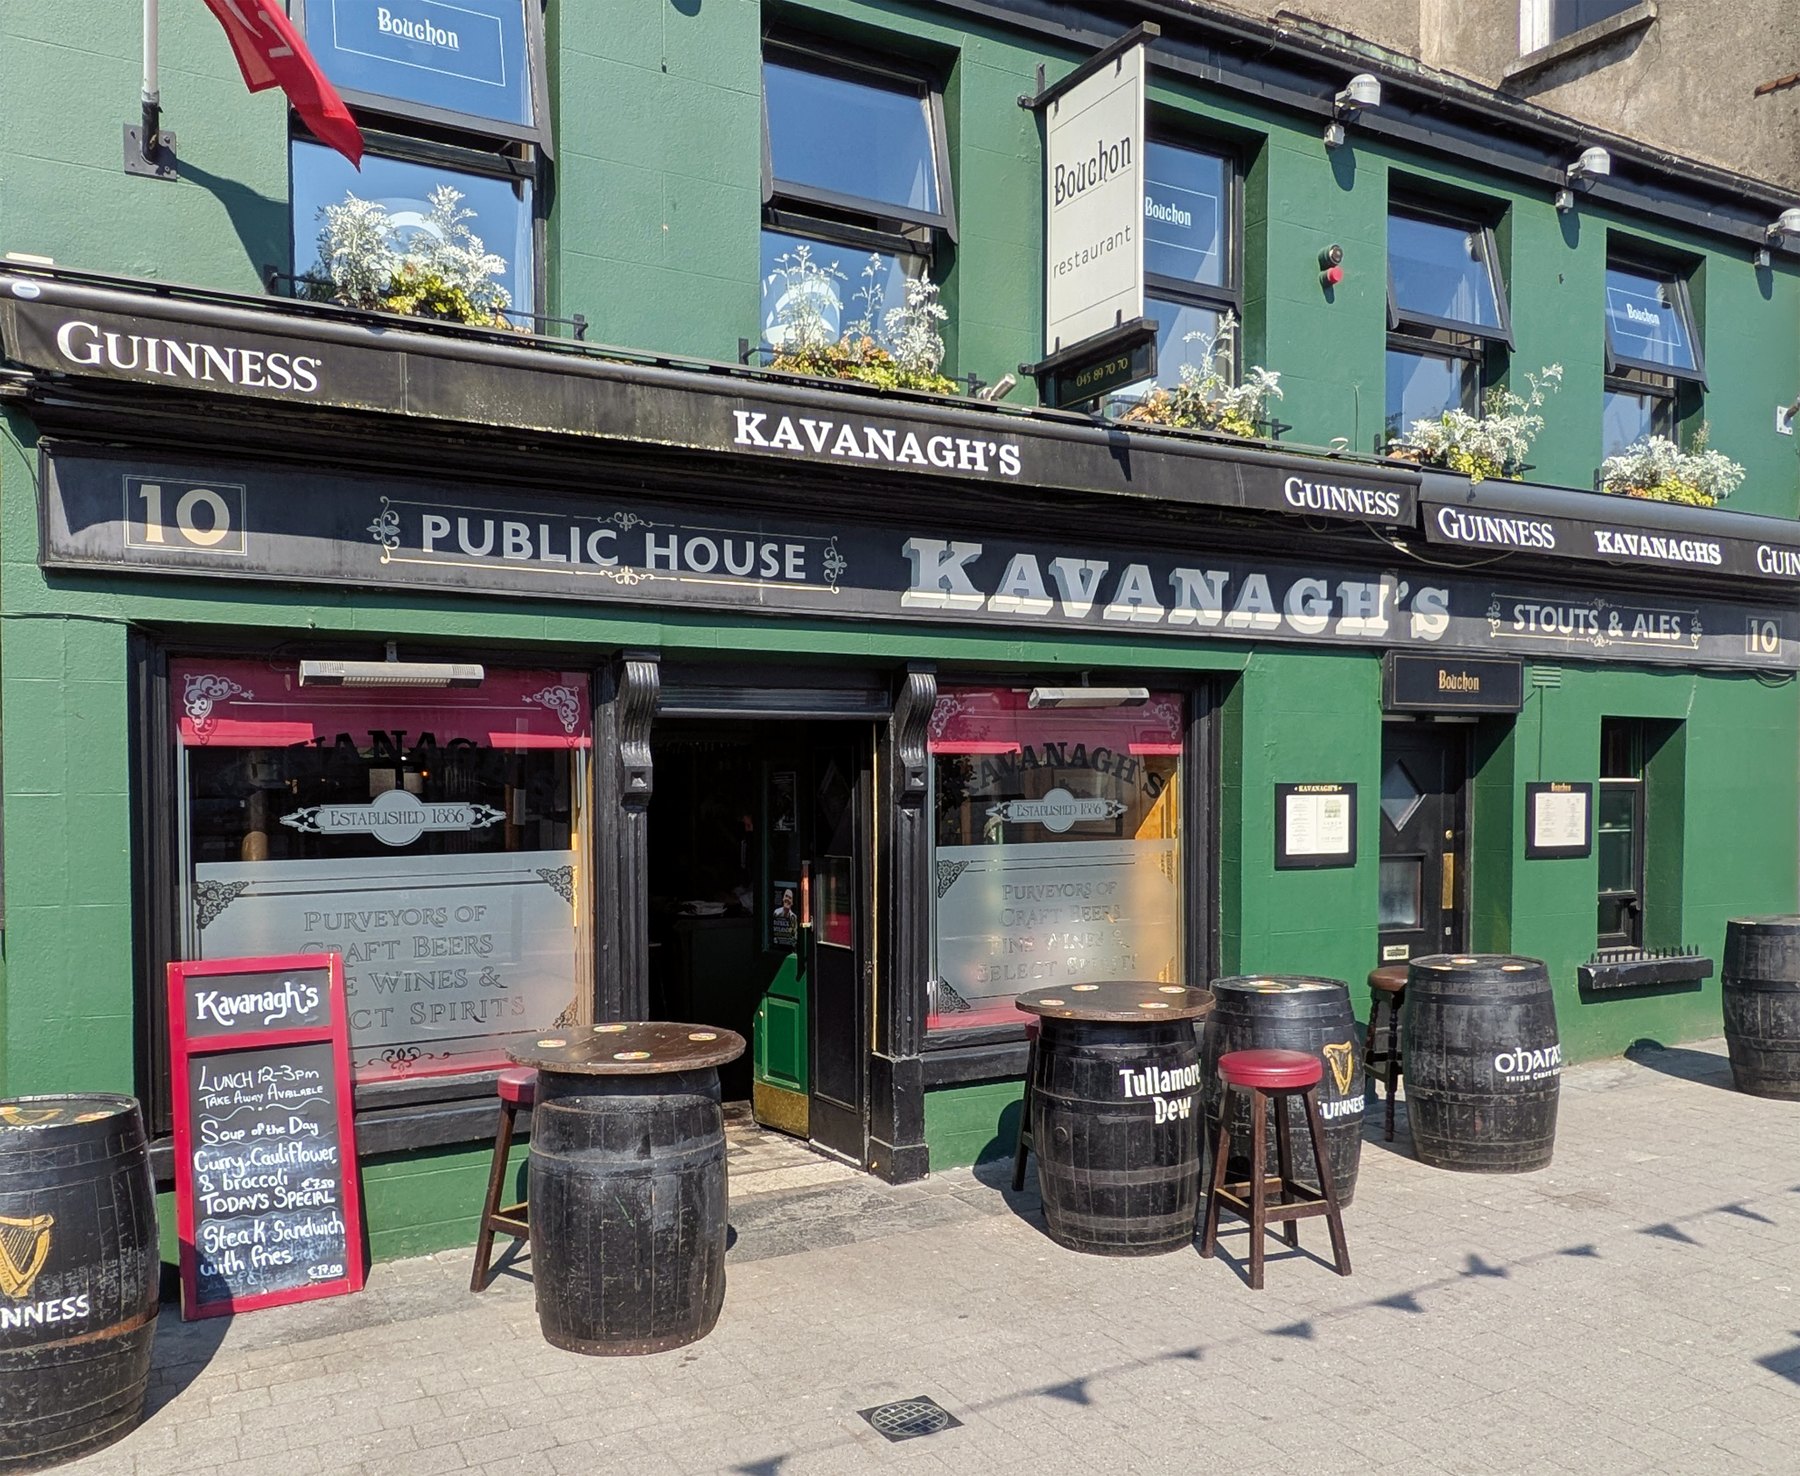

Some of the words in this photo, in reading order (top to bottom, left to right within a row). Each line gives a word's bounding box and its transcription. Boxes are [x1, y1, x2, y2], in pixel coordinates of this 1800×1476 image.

[377, 7, 460, 49] Bouchon
[1053, 136, 1132, 206] Bouchon
[1145, 196, 1191, 226] Bouchon
[1053, 225, 1132, 279] restaurant
[1626, 303, 1660, 326] Bouchon
[56, 321, 322, 392] GUINNESS
[1076, 373, 1091, 387] 045
[1093, 367, 1103, 381] 89
[1105, 362, 1115, 374] 70
[1117, 357, 1128, 370] 70
[733, 410, 1021, 476] KAVANAGH'S
[1285, 477, 1400, 517] GUINNESS
[139, 484, 230, 546] 10
[1438, 507, 1555, 549] GUINNESS
[421, 513, 619, 567] PUBLIC
[646, 532, 807, 579] HOUSE
[1594, 531, 1722, 565] KAVANAGHS
[902, 537, 1449, 641] KAVANAGH'S
[1513, 604, 1599, 635] STOUTS
[1607, 611, 1623, 637] &
[1631, 613, 1681, 640] ALES
[1751, 620, 1778, 652] 10
[1439, 669, 1480, 692] Bouchon
[330, 810, 426, 827] ESTABLISHED
[432, 808, 465, 824] 1886
[1016, 804, 1077, 817] ESTABLISHED
[1001, 882, 1092, 902] PURVEYORS
[1095, 881, 1118, 896] OF
[304, 907, 448, 932] PURVEYORS
[454, 905, 487, 923] OF
[413, 934, 494, 958] BEERS
[368, 968, 469, 994] WINES
[479, 966, 509, 989] &
[195, 981, 319, 1026] Kavanagh's
[410, 995, 525, 1025] SPIRITS
[198, 1065, 254, 1092] LUNCH
[199, 1093, 231, 1109] TAKE
[1153, 1096, 1192, 1124] Dew
[201, 1119, 246, 1144] Soup
[251, 1123, 265, 1136] of
[266, 1123, 286, 1135] the
[288, 1116, 319, 1136] Day
[200, 1174, 215, 1192] &
[223, 1168, 289, 1191] broccoli
[199, 1191, 270, 1215] TODAY'S
[273, 1186, 336, 1209] SPECIAL
[272, 1211, 345, 1243] Sandwich
[201, 1250, 245, 1276] with
